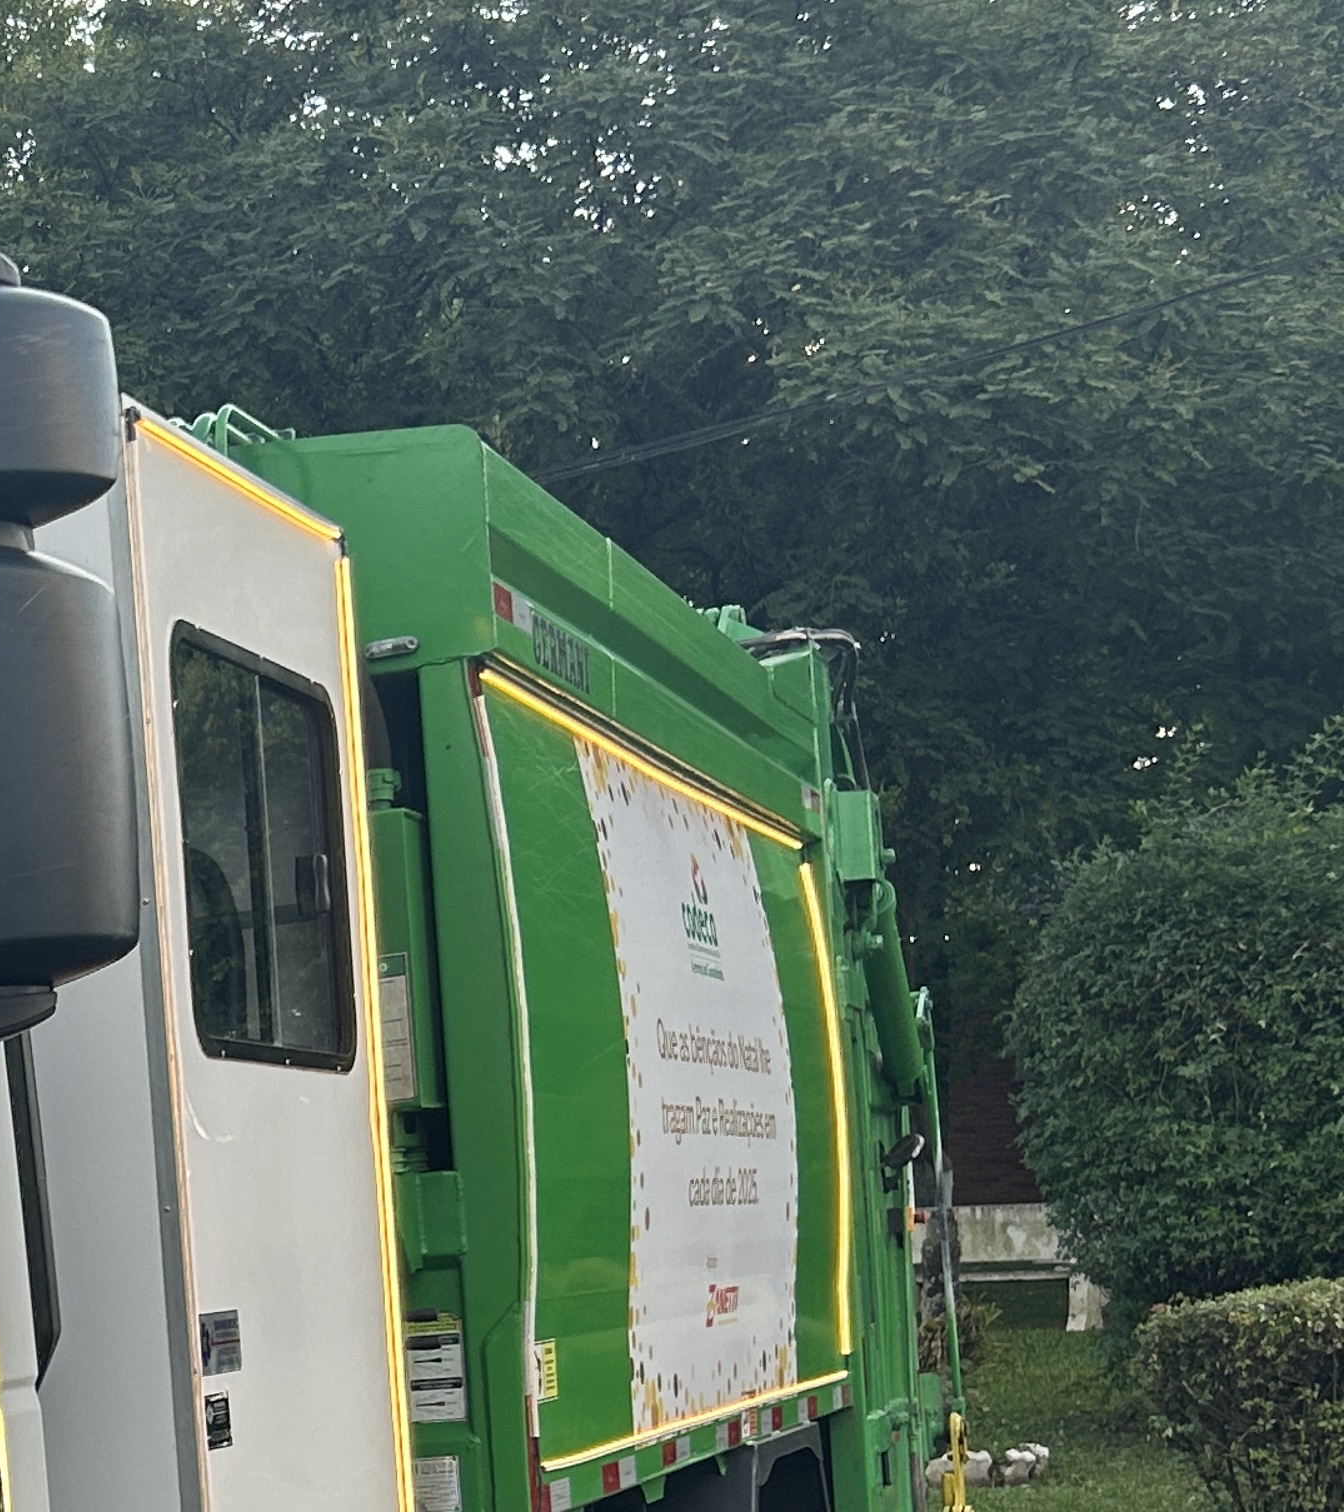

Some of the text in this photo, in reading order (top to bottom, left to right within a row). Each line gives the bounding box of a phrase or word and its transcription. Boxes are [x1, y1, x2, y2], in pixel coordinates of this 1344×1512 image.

[680, 890, 719, 948] codeca
[657, 1018, 678, 1061] Que
[680, 1032, 690, 1062] as
[661, 1096, 694, 1146] tragam
[695, 1096, 711, 1135] Paz
[688, 1165, 710, 1207] cada
[725, 1166, 737, 1206] de
